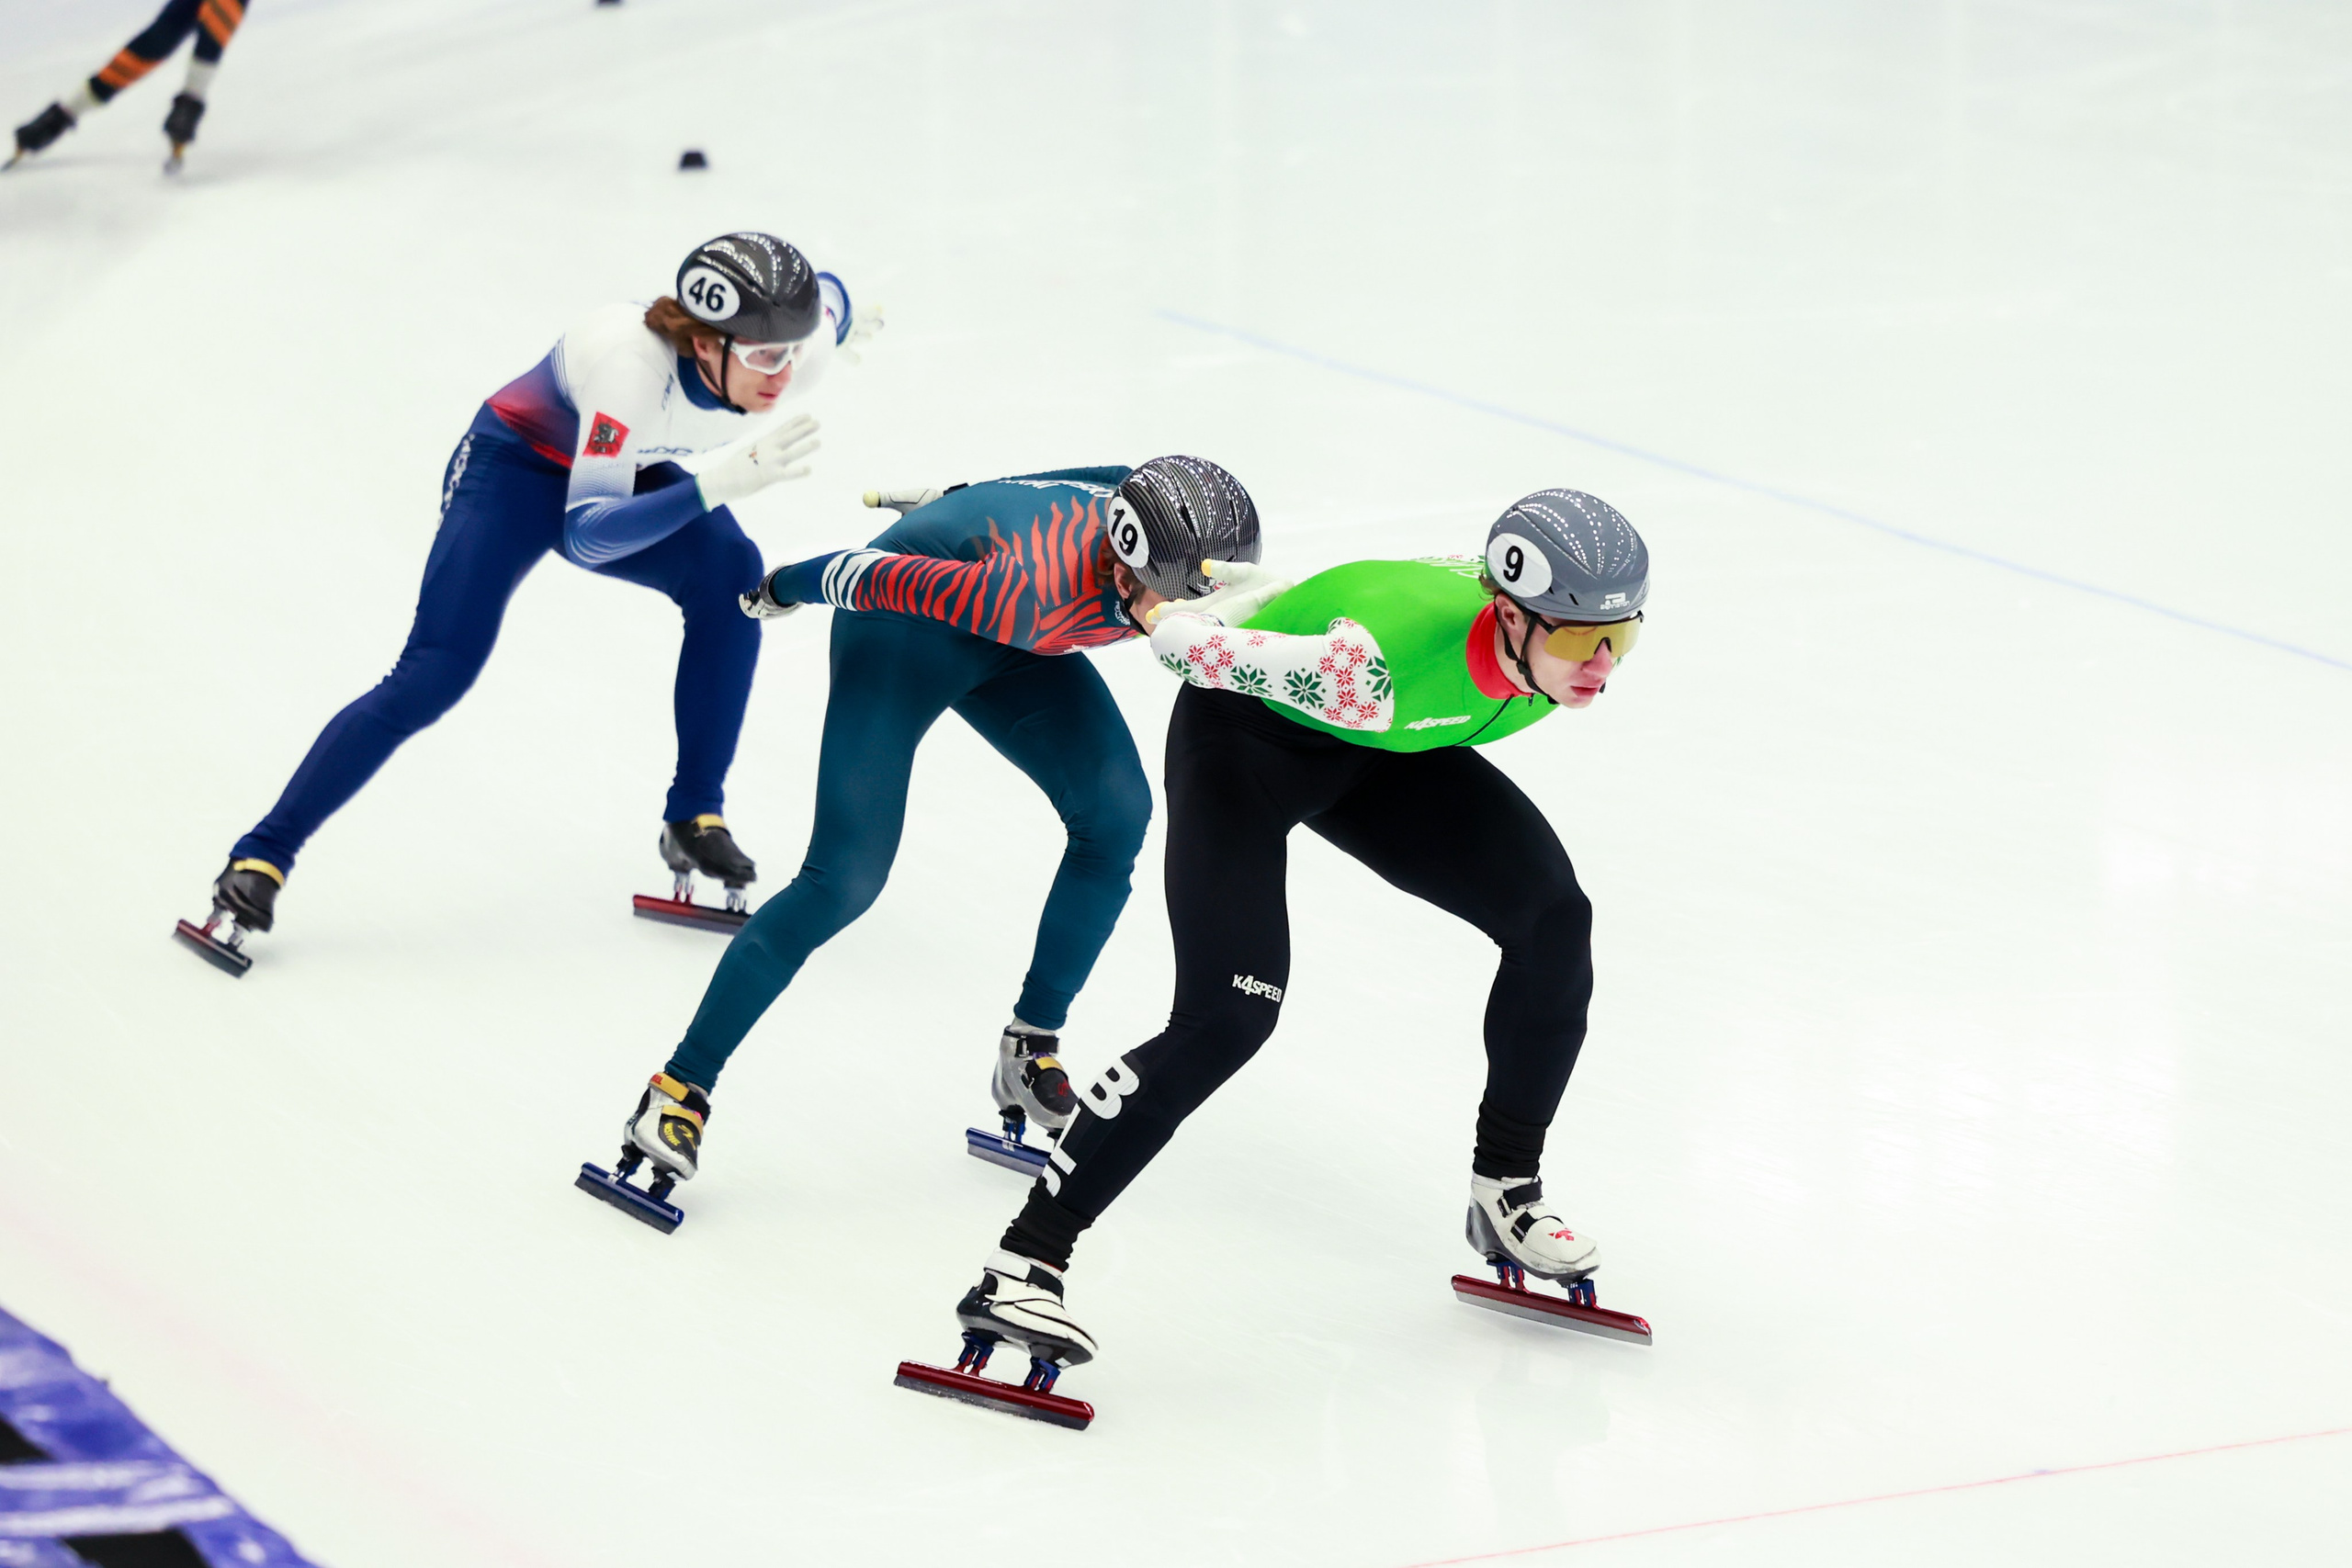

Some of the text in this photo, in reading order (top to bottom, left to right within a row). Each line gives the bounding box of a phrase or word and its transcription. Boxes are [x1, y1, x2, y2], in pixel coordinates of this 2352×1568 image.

[688, 276, 726, 312] 46
[1111, 508, 1138, 557] 19
[1503, 545, 1524, 582] 9
[1232, 974, 1283, 1003] K4SPEED
